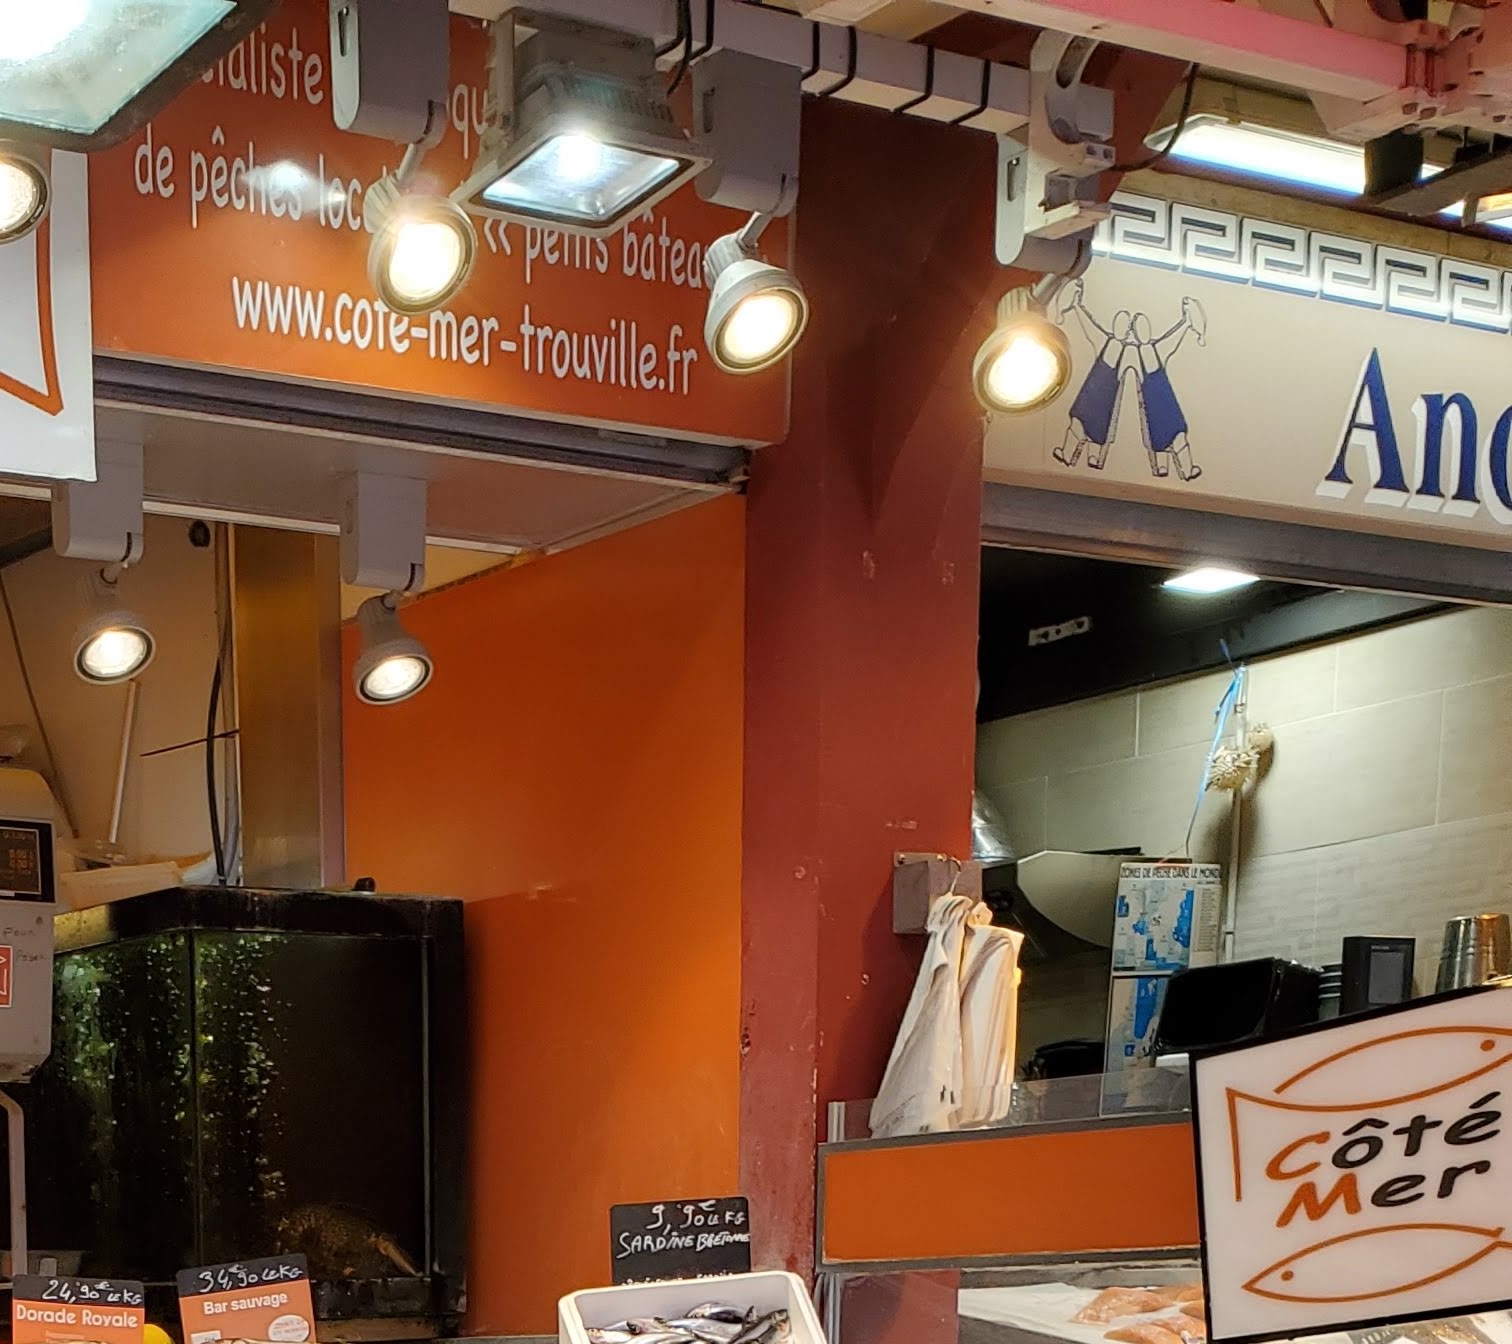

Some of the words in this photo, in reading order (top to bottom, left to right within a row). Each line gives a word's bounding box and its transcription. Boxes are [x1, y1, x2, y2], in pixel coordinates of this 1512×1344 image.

[231, 276, 698, 395] www.cote-mer-trouville.fr
[1264, 1090, 1502, 1182] Côté
[1275, 1158, 1491, 1230] Mer
[16, 1304, 77, 1325] Dorade
[81, 1308, 138, 1328] Royale
[203, 1300, 228, 1316] Bar
[231, 1291, 288, 1311] sauvage
